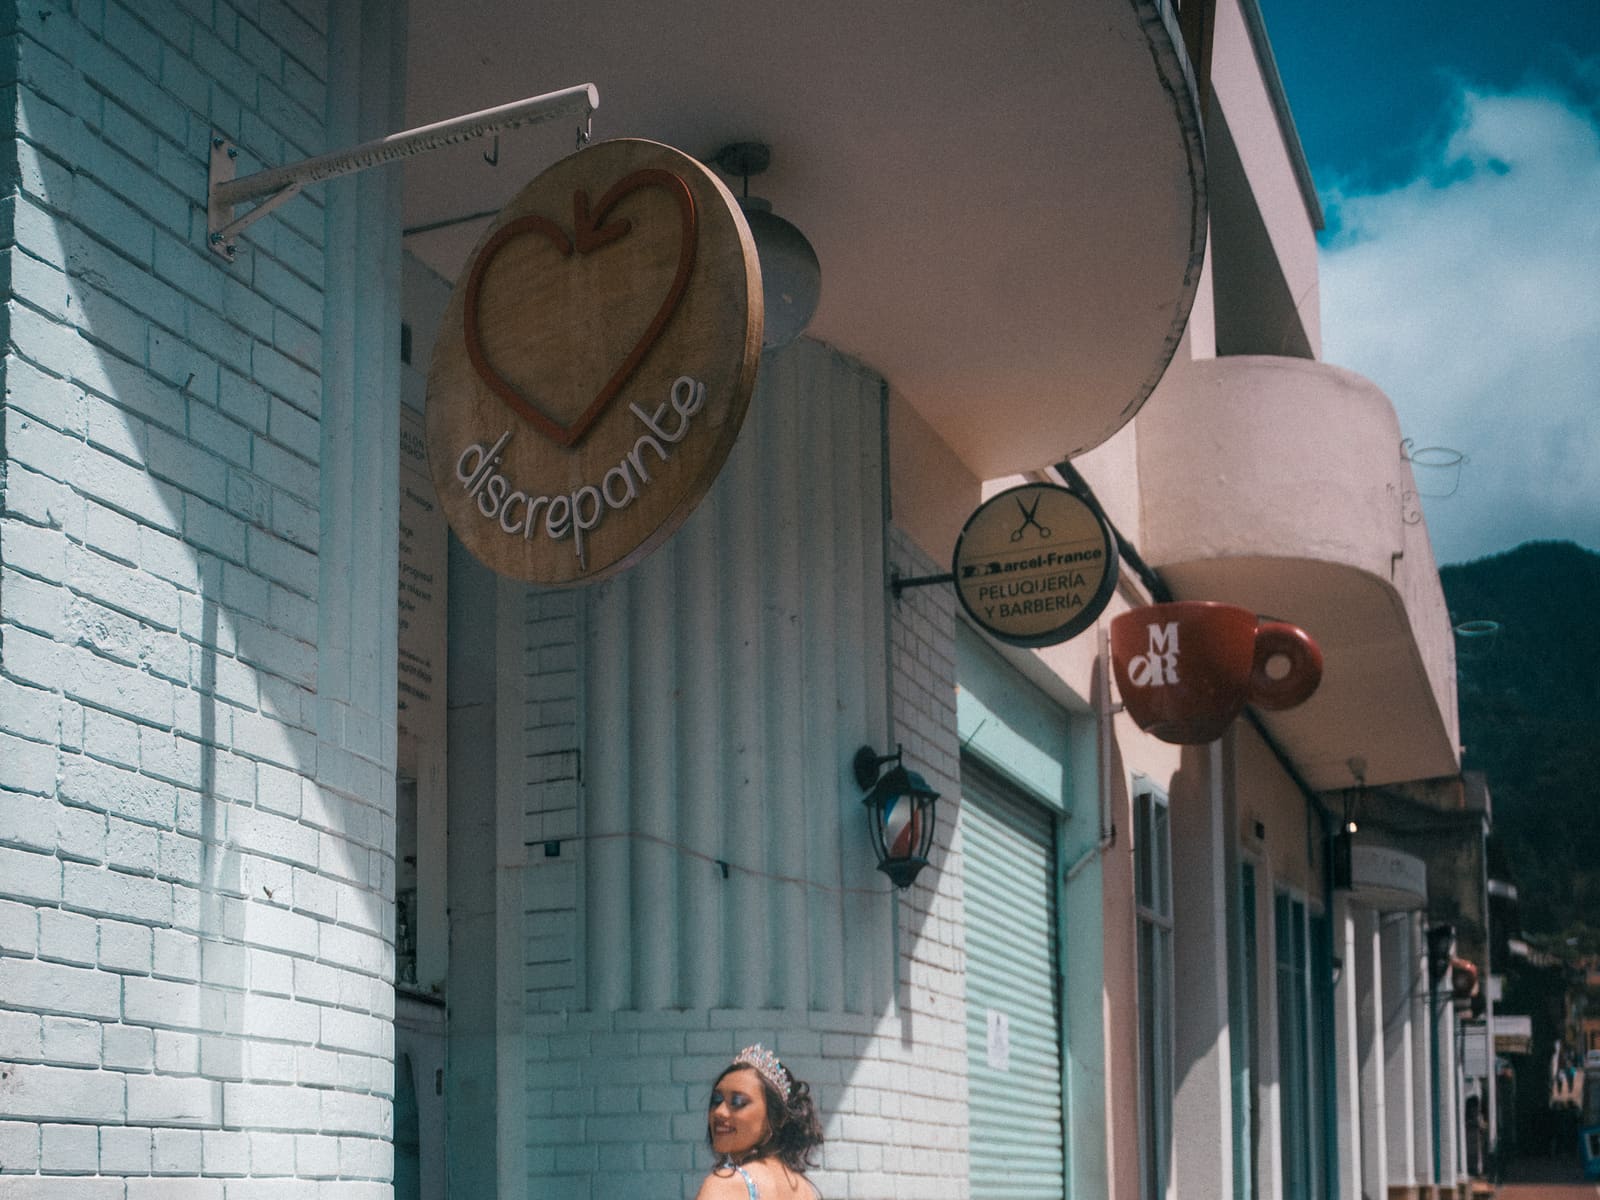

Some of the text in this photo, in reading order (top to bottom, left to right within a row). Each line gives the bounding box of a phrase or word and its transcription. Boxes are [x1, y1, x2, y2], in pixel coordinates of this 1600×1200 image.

[456, 375, 705, 568] discrepante
[979, 573, 1086, 600] PELUQUERÍA
[984, 594, 1084, 619] Y BARBERÍA
